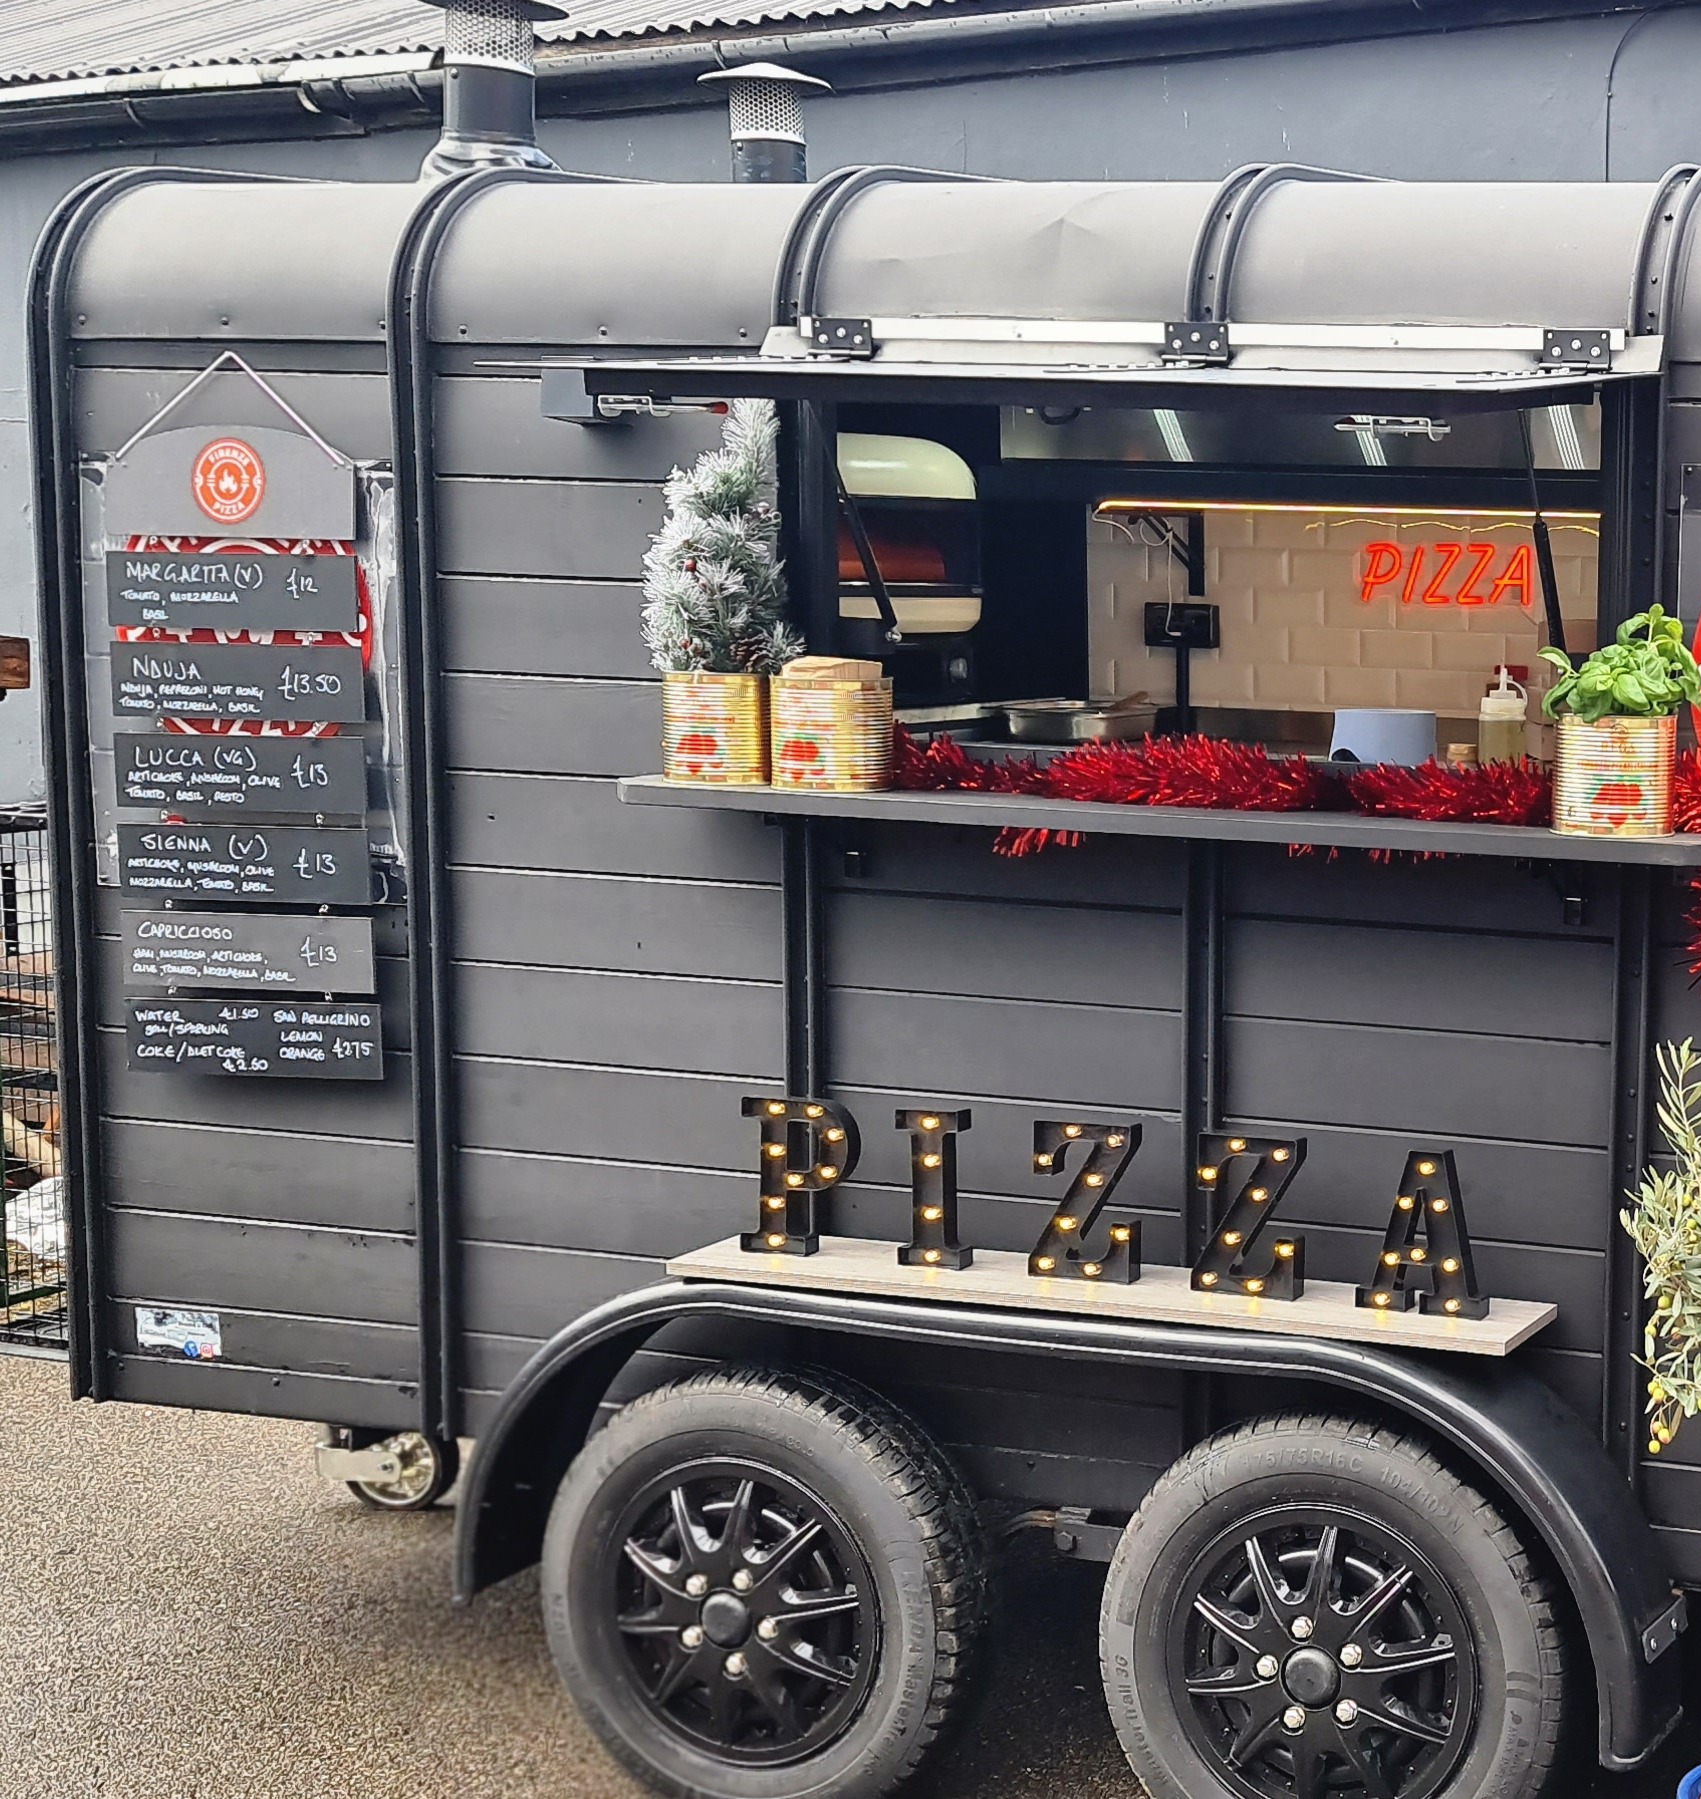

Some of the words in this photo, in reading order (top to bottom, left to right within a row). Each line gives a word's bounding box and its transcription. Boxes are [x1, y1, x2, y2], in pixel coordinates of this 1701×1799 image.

[286, 567, 319, 599] £12
[1361, 543, 1534, 607] PIZZA
[132, 654, 202, 680] NDUJA
[277, 664, 342, 700] £13.50
[212, 684, 233, 695] HOT
[135, 746, 204, 768] LUCCA
[214, 745, 257, 771] (VG)
[290, 754, 329, 788] £13
[247, 775, 281, 789] OLIVE
[140, 833, 212, 852] SIENNA
[228, 834, 267, 861] (V)
[293, 848, 337, 879] £13
[300, 936, 338, 968] £13
[135, 1010, 185, 1023] WATER
[273, 1009, 297, 1023] SAN
[280, 1030, 323, 1042] LEMON
[216, 1047, 246, 1059] COKE
[279, 1047, 325, 1061] ORANGE
[740, 1096, 1491, 1322] PIZZA
